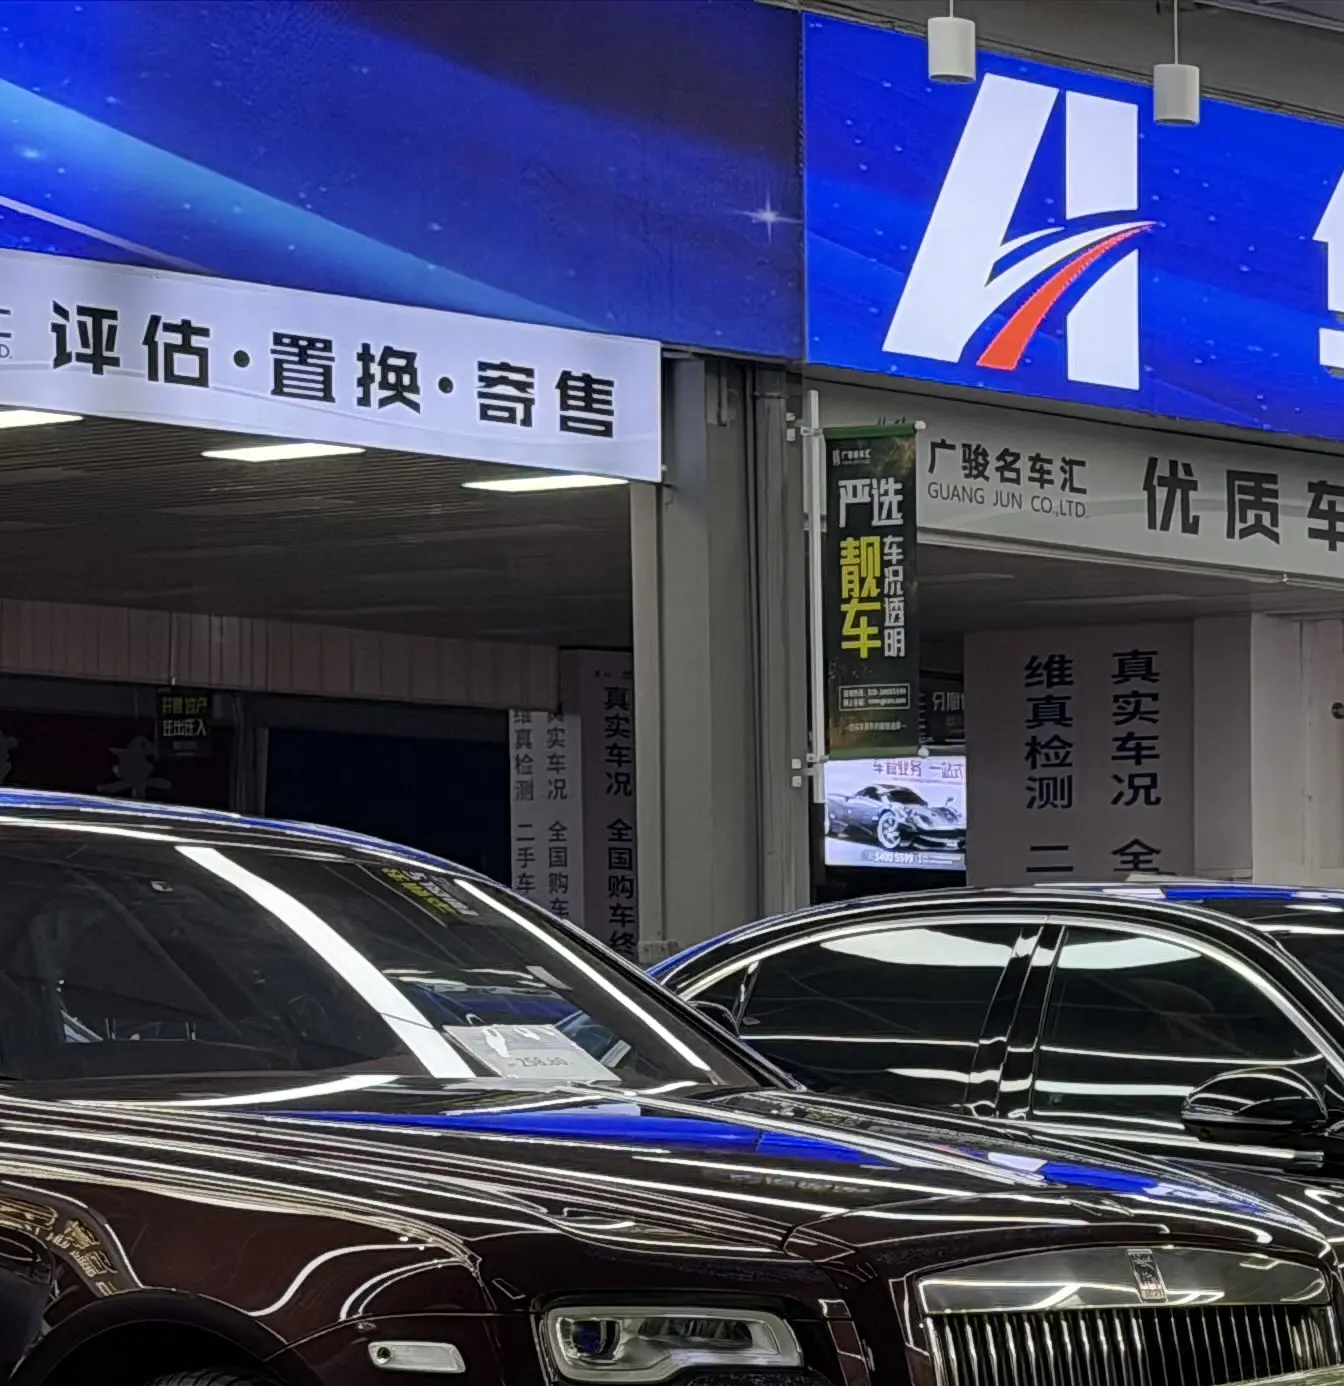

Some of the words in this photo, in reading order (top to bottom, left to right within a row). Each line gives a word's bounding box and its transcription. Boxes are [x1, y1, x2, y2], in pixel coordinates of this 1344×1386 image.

[838, 477, 904, 528] 严选
[927, 438, 1087, 495] 广骏名车汇
[927, 482, 985, 505] GUANG
[992, 488, 1023, 510] JUN
[840, 537, 881, 658] 靓车
[883, 534, 905, 657] 车况透明
[604, 686, 633, 797] 真实车况
[1024, 654, 1073, 809] 维真检测
[1110, 649, 1161, 806] 真实车况
